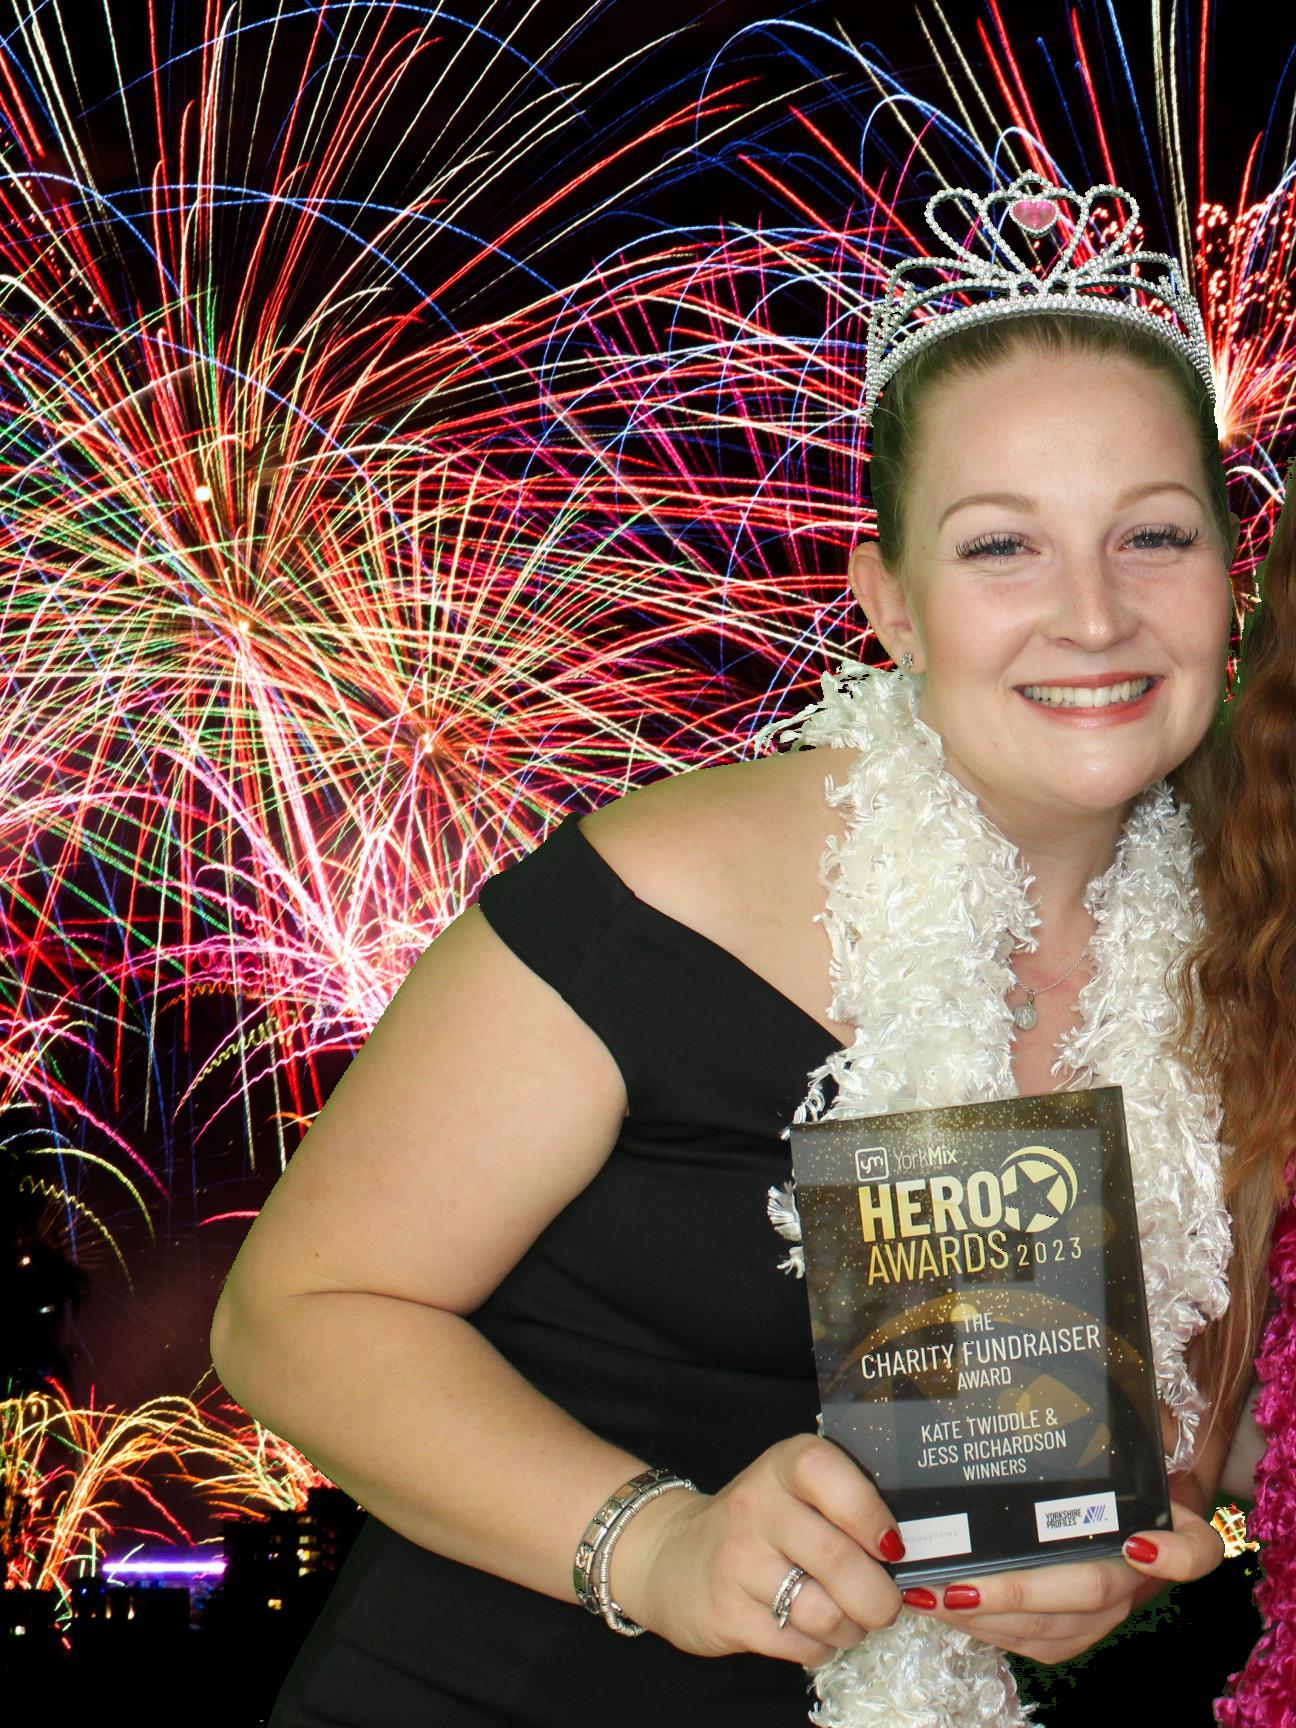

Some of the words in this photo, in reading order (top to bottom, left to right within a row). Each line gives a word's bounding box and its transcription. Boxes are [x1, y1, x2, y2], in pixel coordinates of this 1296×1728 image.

[893, 1147, 957, 1171] YorkMix
[857, 1170, 1002, 1243] HERO
[868, 1230, 1009, 1287] AWARDS
[1016, 1236, 1082, 1268] 2023
[962, 1312, 994, 1334] THE
[861, 1343, 954, 1380] CHARITY
[962, 1325, 1101, 1366] FUNDRAISER
[957, 1367, 1012, 1391] AWARD
[920, 1421, 963, 1444] KATE
[966, 1410, 1039, 1438] TWIDDLE
[1045, 1407, 1058, 1426] &
[918, 1445, 959, 1469] JESS
[963, 1430, 1067, 1461] RICHARDSON
[963, 1458, 1027, 1482] WINNERS
[1045, 1508, 1082, 1521] YORKSHIRE
[1046, 1519, 1078, 1529] PROFILES
